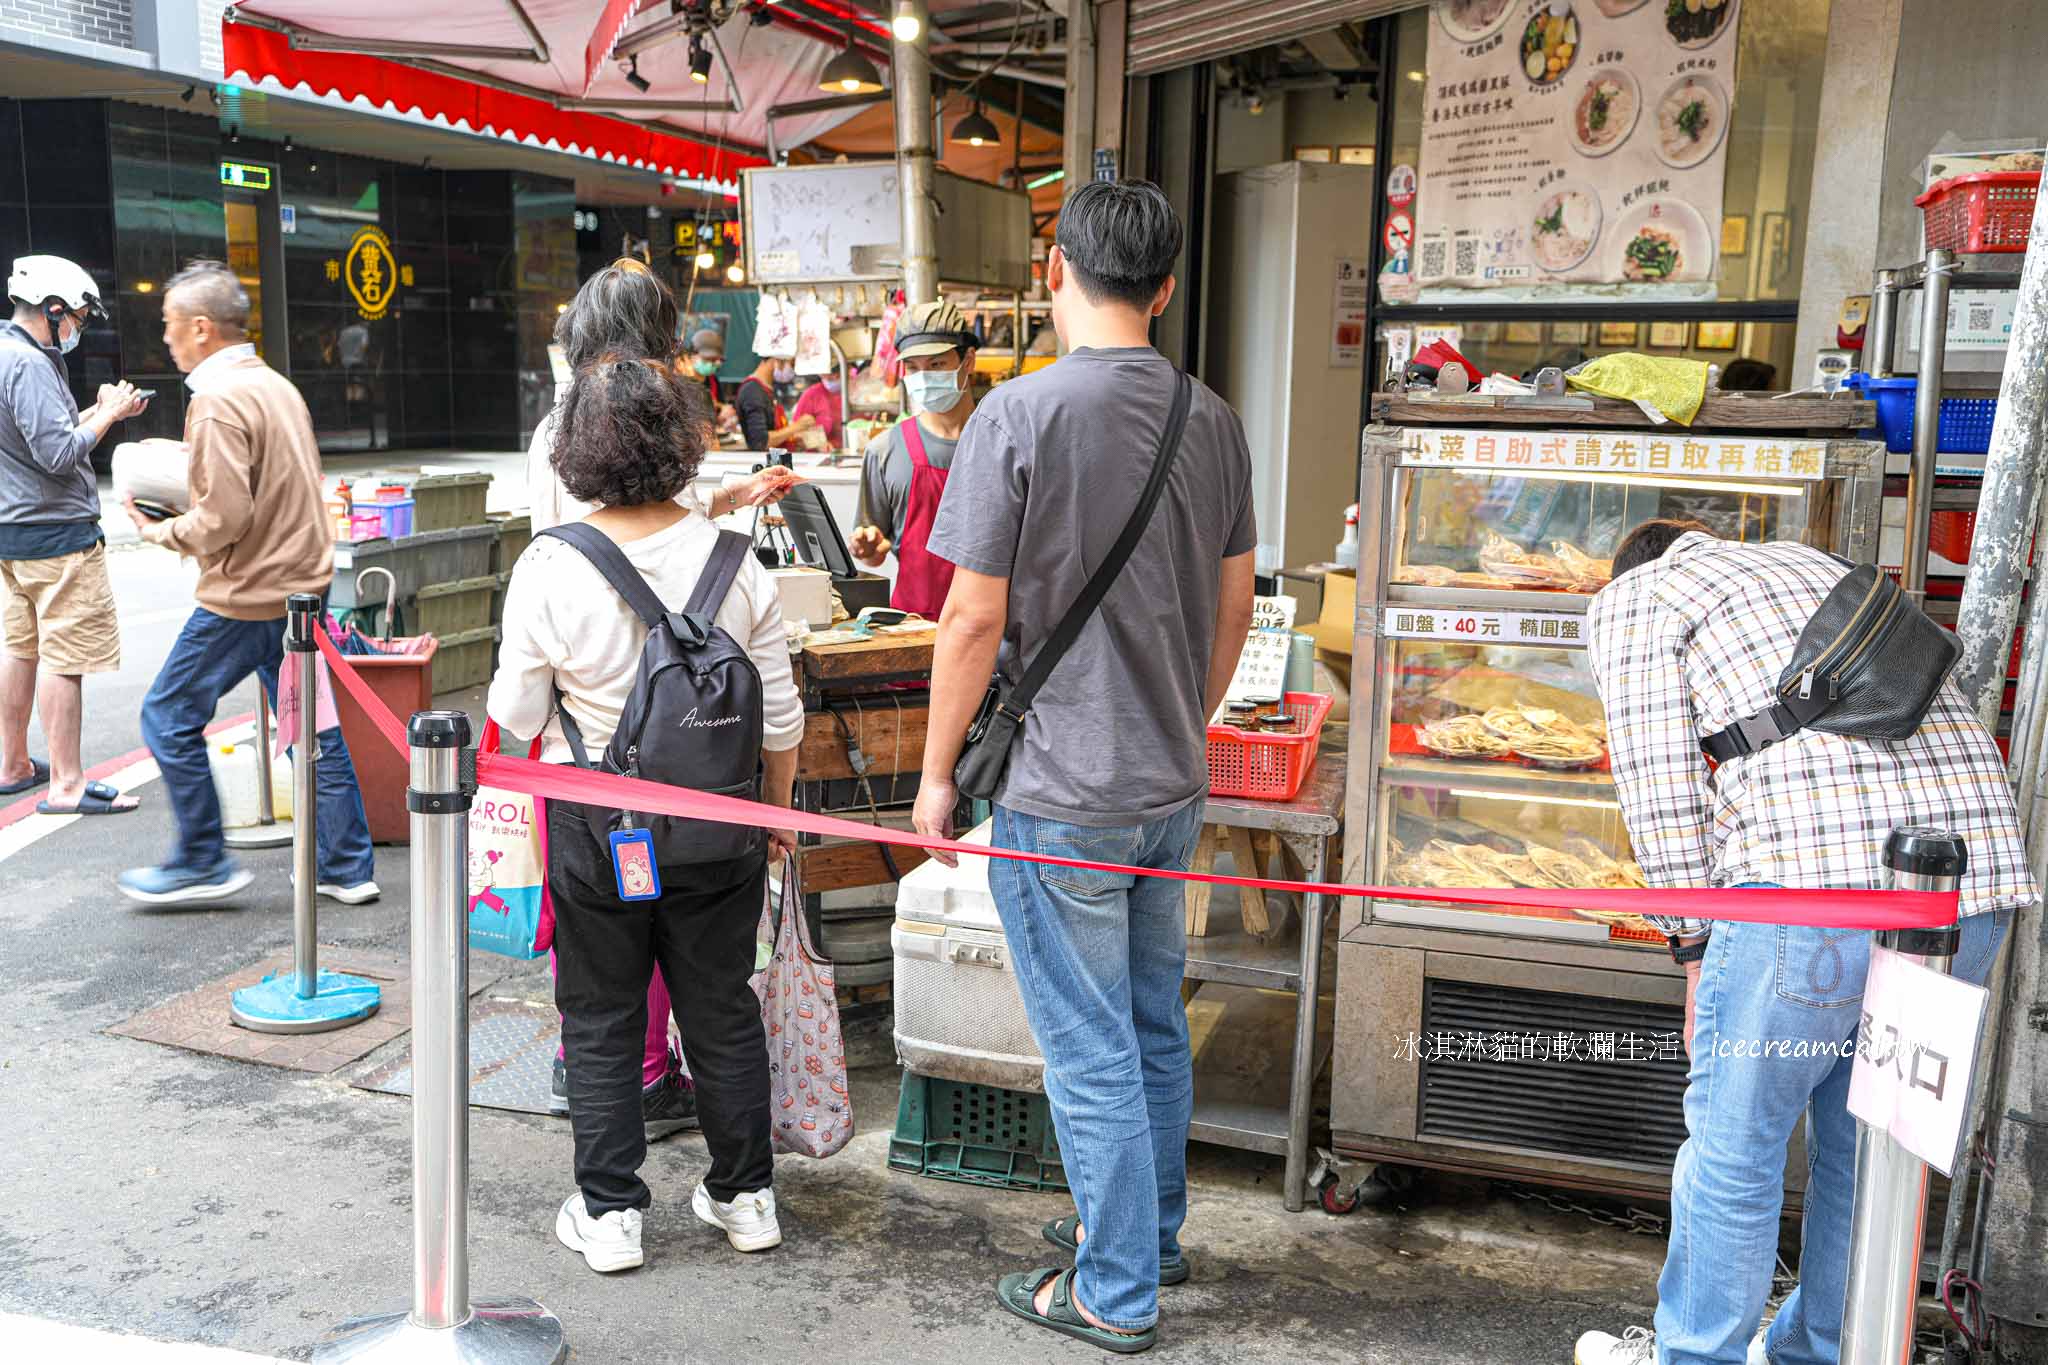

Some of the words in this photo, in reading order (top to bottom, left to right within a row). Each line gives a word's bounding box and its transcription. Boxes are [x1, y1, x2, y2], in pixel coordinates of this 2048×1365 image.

[1408, 434, 1821, 474] 小菜自助式請先自取再結帳
[679, 706, 742, 729] Awesome
